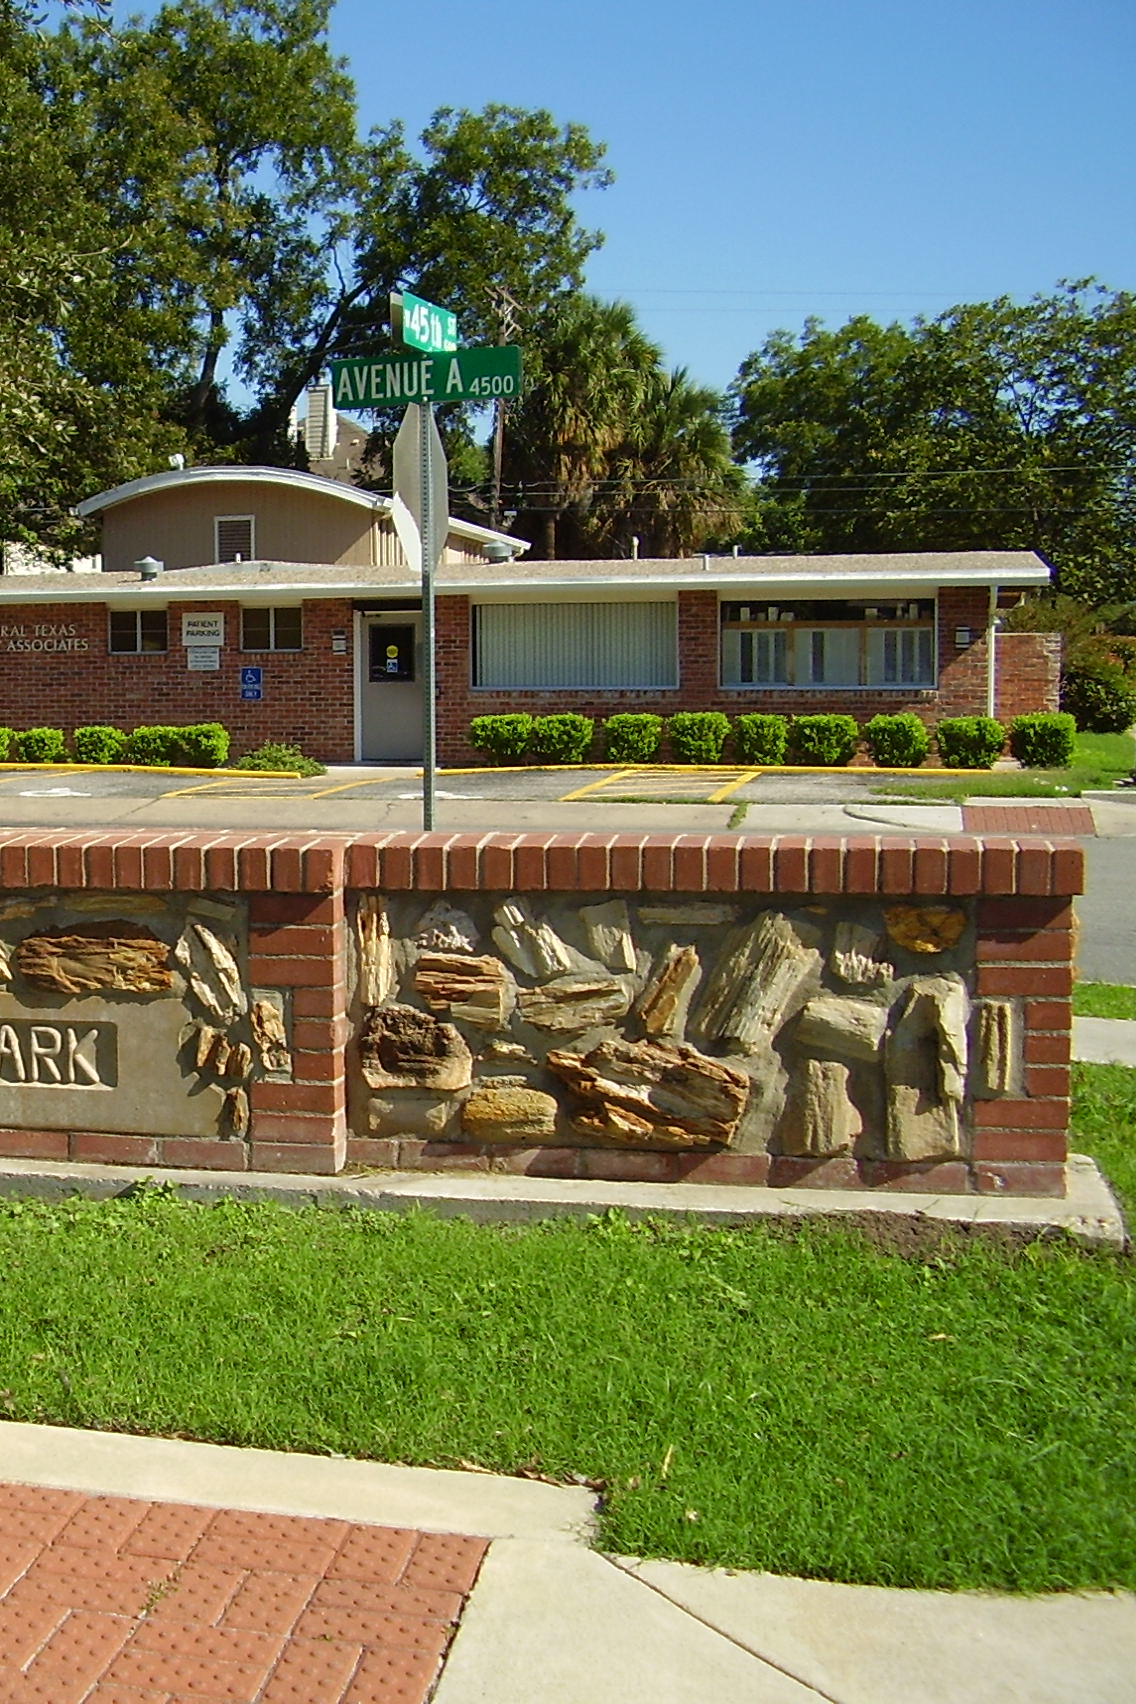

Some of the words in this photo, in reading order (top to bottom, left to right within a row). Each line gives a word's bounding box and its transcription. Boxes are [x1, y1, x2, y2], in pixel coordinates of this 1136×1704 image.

[410, 303, 442, 349] 45th
[337, 359, 435, 402] AVENUE
[445, 357, 464, 395] A
[468, 375, 514, 396] 4500
[33, 623, 77, 637] TEXAS
[187, 620, 219, 628] PATIENT
[186, 629, 221, 637] PARKING
[6, 637, 90, 652] ASSOCIATES
